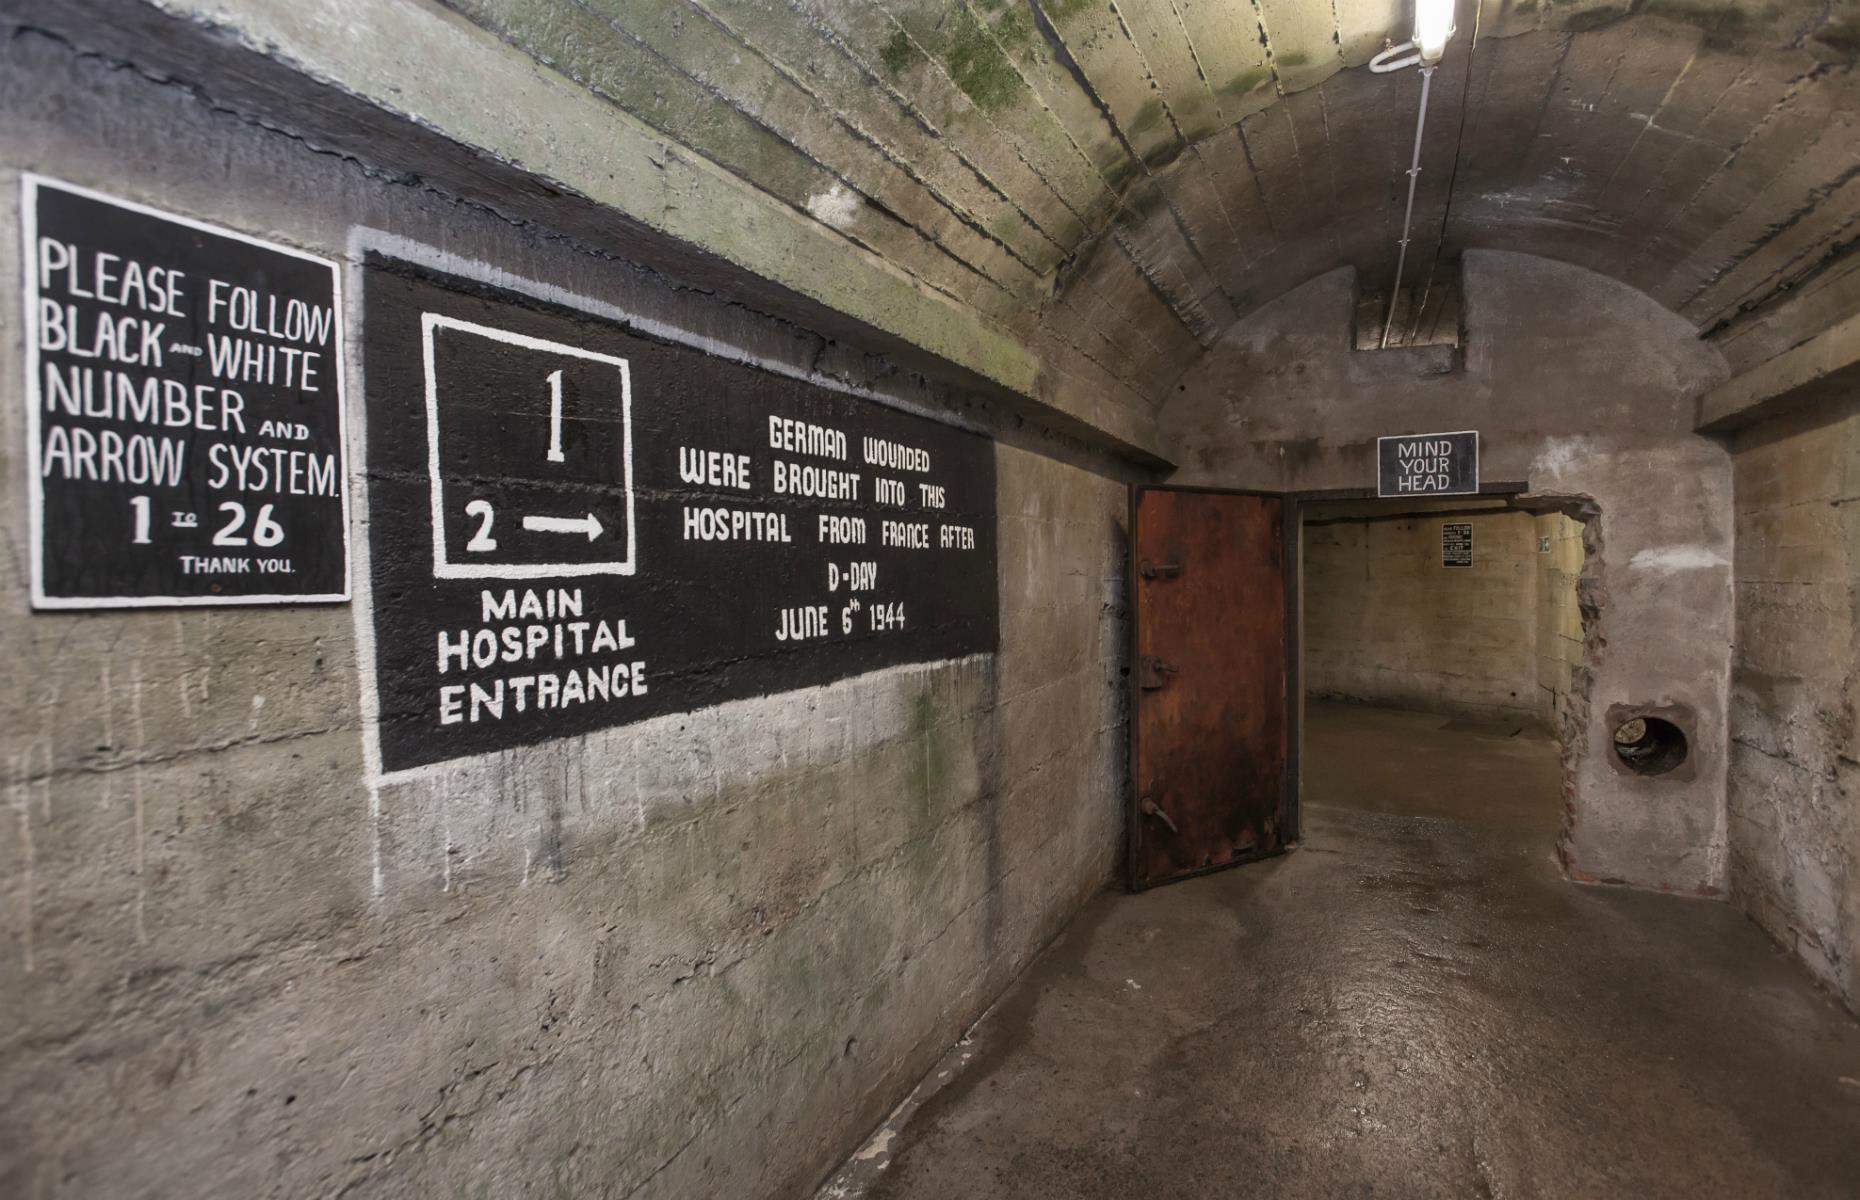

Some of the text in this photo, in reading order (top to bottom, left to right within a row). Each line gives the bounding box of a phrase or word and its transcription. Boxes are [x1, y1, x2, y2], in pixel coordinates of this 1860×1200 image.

[39, 237, 332, 346] PLEASE FOLLOW
[39, 298, 321, 391] BLACK AND WHITE
[46, 362, 309, 440] NUMBER AND
[546, 369, 565, 463] 1
[43, 426, 340, 498] ARROW SYSTEM.
[769, 415, 930, 473] GERMAN WOUNDED
[1398, 441, 1452, 458] MIND
[1399, 457, 1450, 475] YOUR
[679, 446, 945, 508] WERE BROUGHT INTO THIS
[1398, 474, 1450, 491] HEAD
[129, 496, 152, 544] 1
[212, 501, 285, 547] 26
[465, 500, 497, 552] 2
[683, 506, 975, 550] HOSPITAL FROM FRANCE AFTER
[179, 556, 296, 574] THANK YOU.
[828, 562, 877, 592] D-DAY
[481, 588, 583, 623] MAIN
[775, 606, 828, 641] JUNE
[869, 601, 905, 631] 1944
[436, 619, 635, 674] HOSPITAL
[439, 661, 648, 725] ENTRANCE
